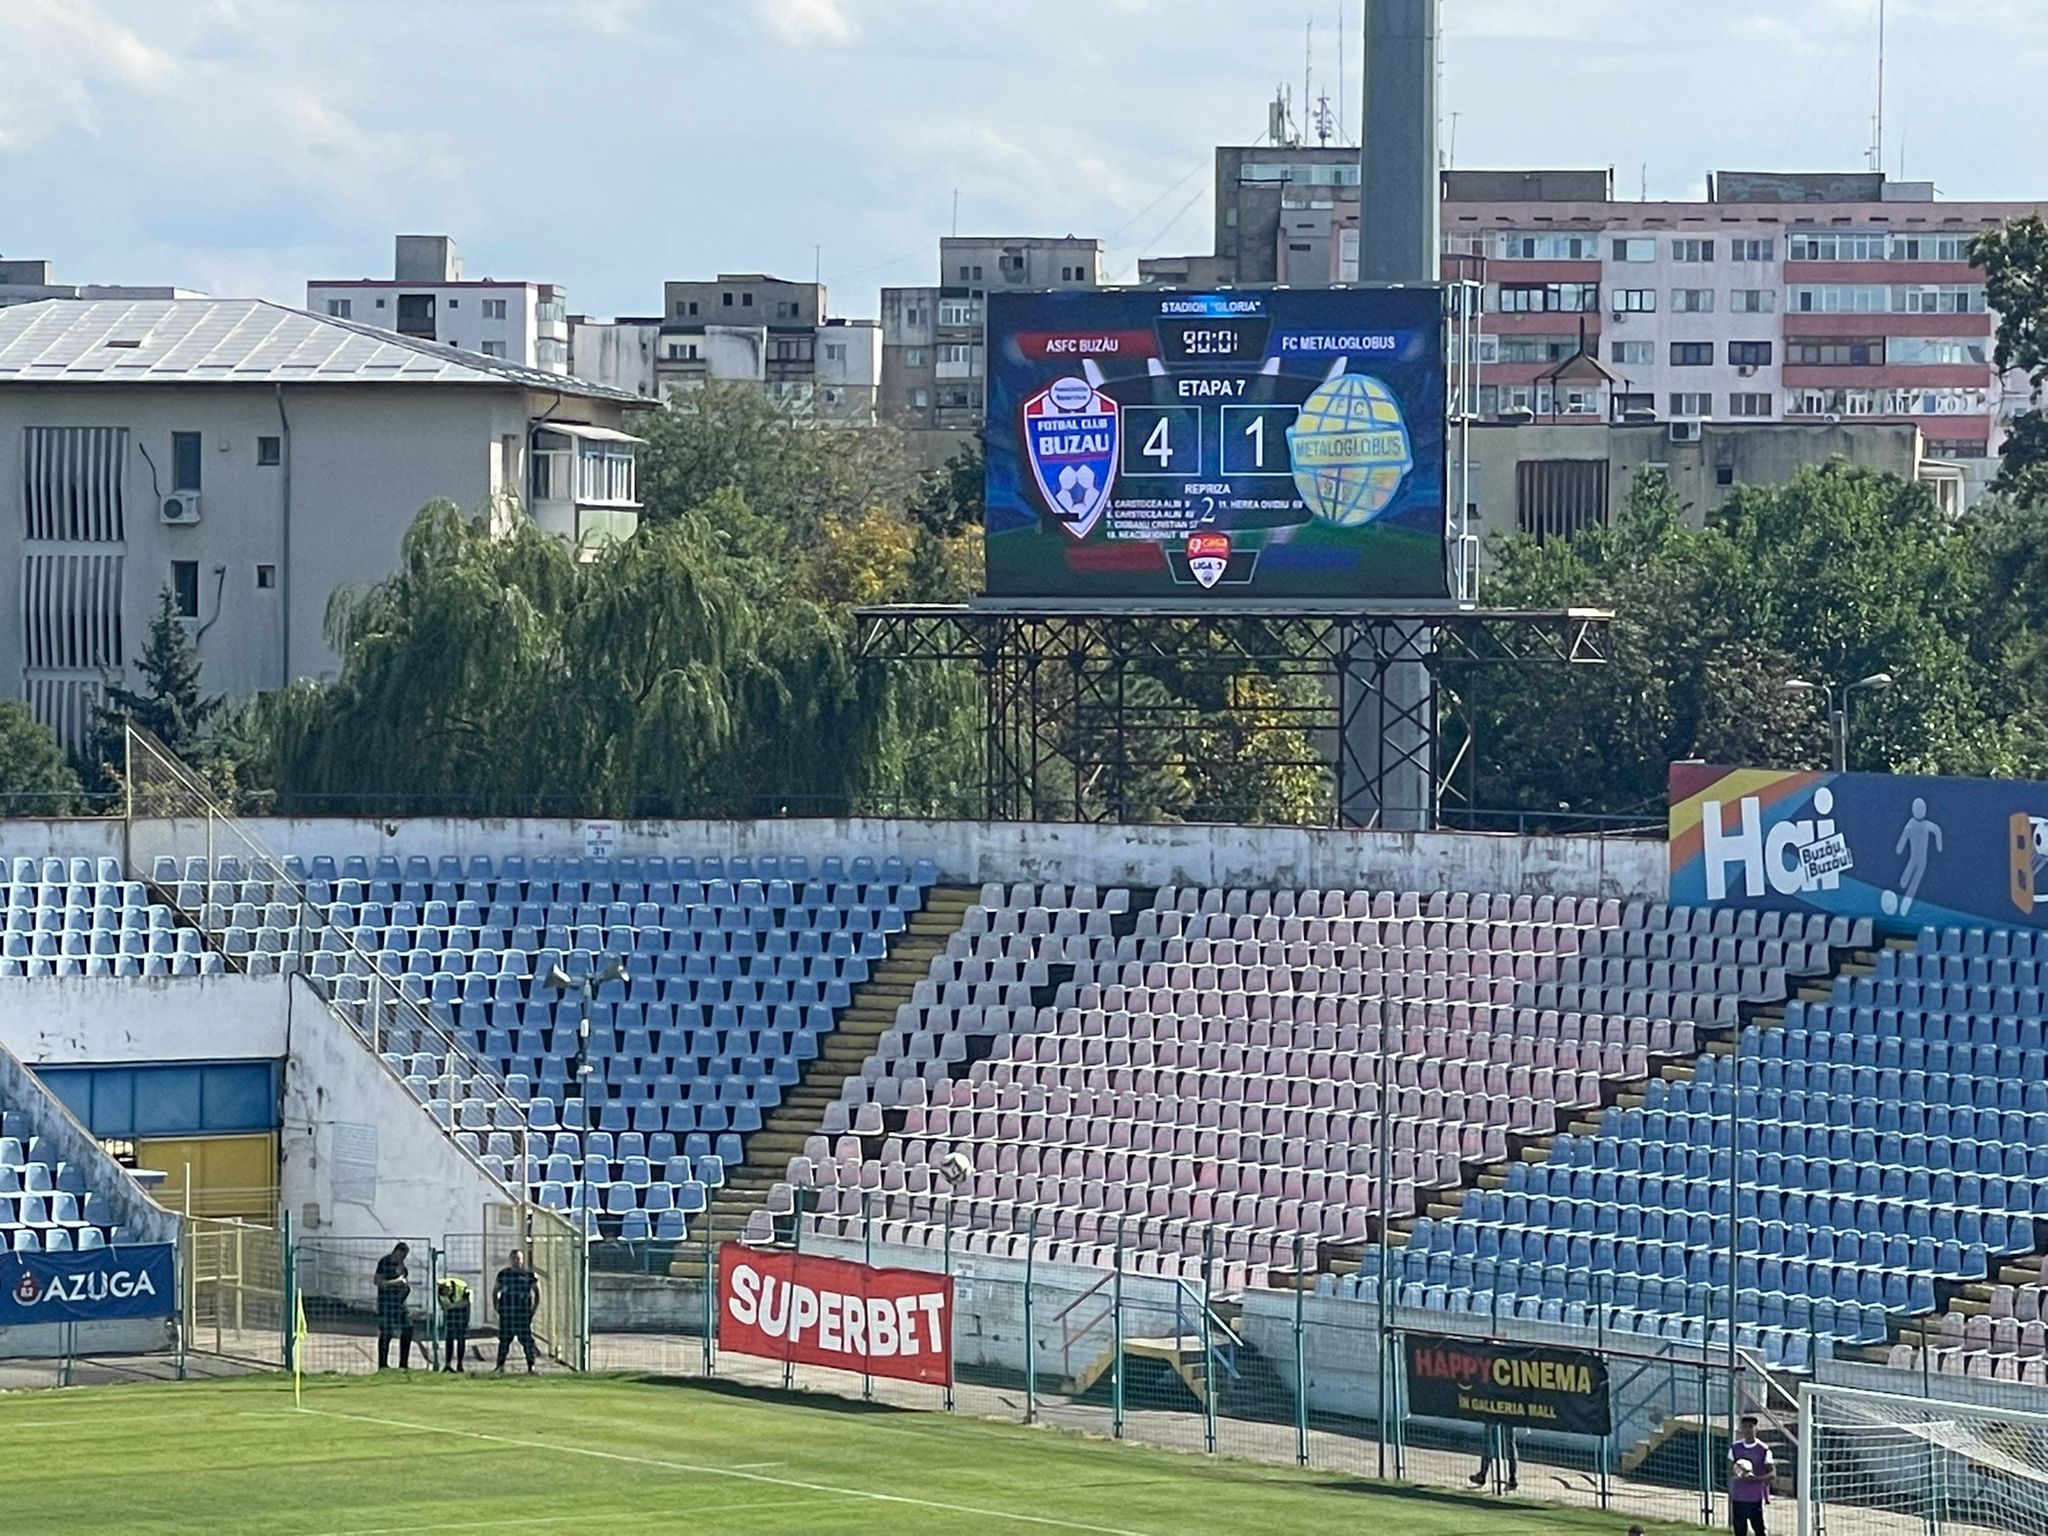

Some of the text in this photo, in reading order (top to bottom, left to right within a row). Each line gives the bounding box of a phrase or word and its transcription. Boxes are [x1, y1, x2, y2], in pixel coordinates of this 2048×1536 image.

[1161, 301, 1261, 313] STADION "GLORIA"
[1046, 339, 1077, 352] ASFC
[1183, 331, 1238, 353] 90:01
[1282, 335, 1396, 350] FC METALOGLOBUS
[1179, 379, 1246, 396] ETAPA 7
[1037, 419, 1108, 431] FOTBAL CLUB
[1039, 433, 1110, 455] BUZAU
[1143, 417, 1173, 467] 4
[1245, 415, 1263, 467] 1
[1296, 434, 1401, 458] METALOGLOBUS
[1184, 484, 1231, 494] REPRIZA
[1200, 496, 1216, 523] 2
[1702, 787, 1840, 901] Hai
[43, 1270, 156, 1302] AZUGA
[729, 1264, 945, 1357] SUPERBET
[1472, 1398, 1526, 1416] GALLERIA
[1528, 1403, 1557, 1418] MALL
